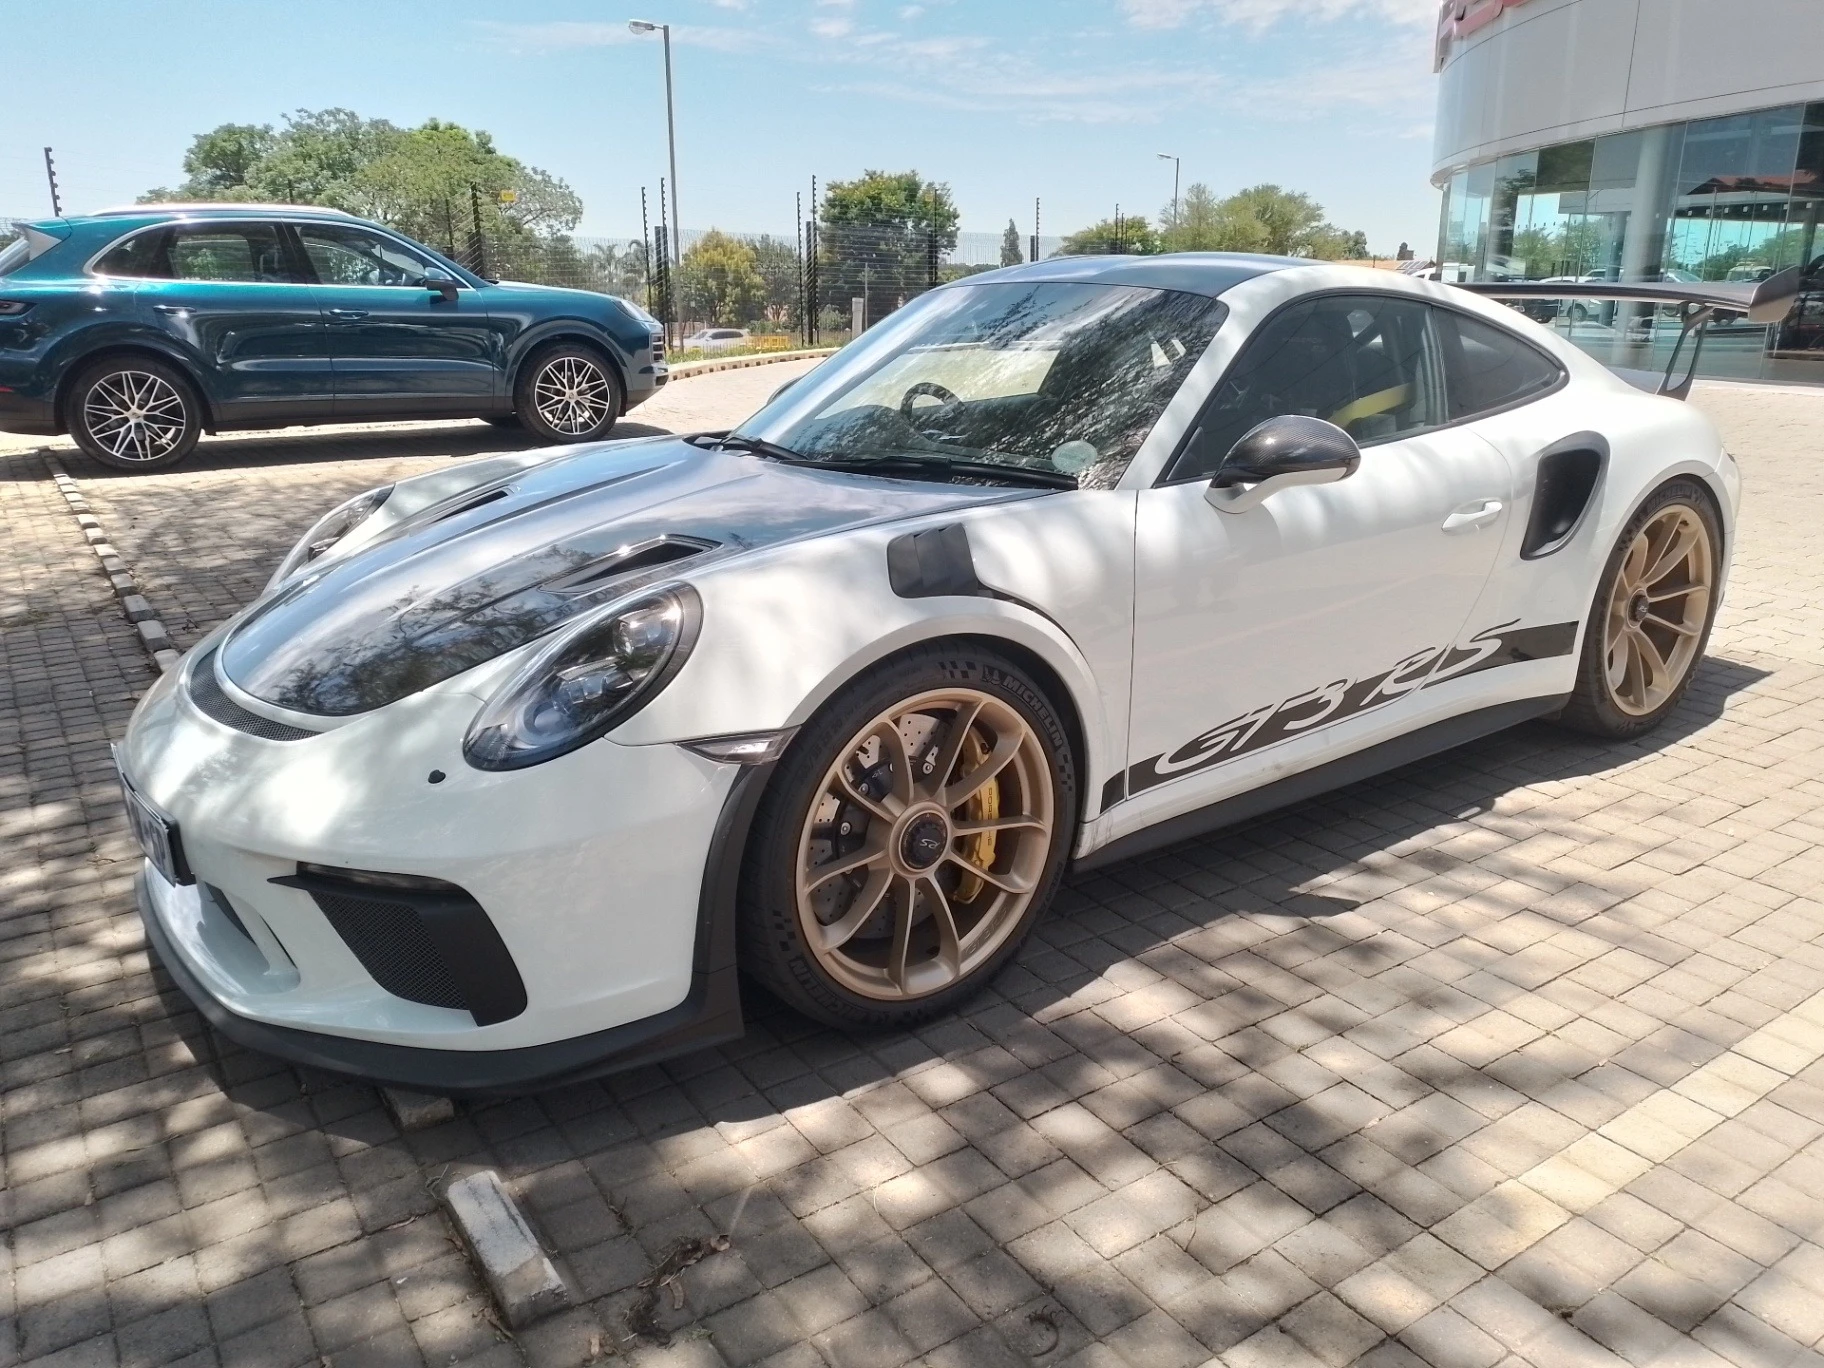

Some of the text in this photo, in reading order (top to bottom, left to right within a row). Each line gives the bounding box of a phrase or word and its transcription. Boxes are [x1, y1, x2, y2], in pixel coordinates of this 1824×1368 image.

[1003, 674, 1065, 749] MICHELIN
[1154, 677, 1360, 775] GT3
[1360, 618, 1523, 706] RS
